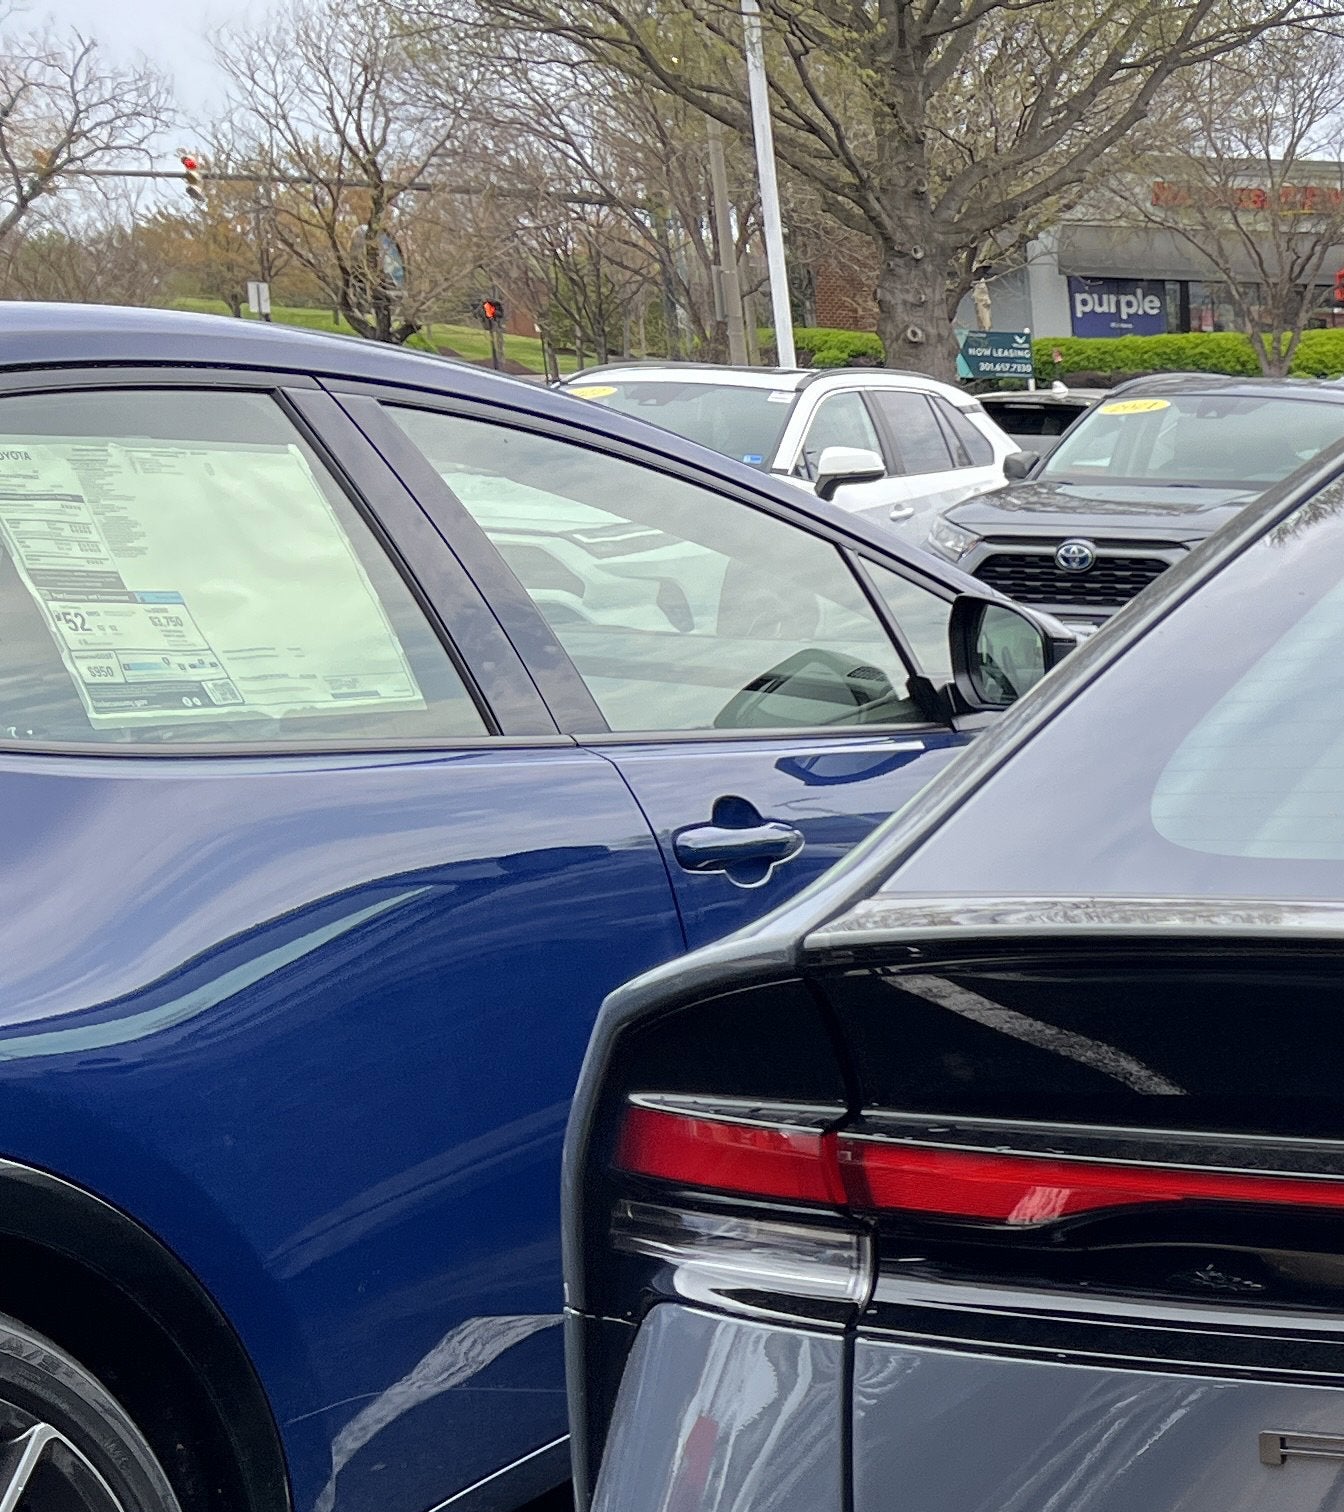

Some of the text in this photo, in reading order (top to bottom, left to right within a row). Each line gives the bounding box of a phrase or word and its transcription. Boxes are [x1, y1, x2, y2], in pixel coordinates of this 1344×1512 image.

[1073, 287, 1161, 320] purple
[968, 347, 1032, 358] NOW LEASING
[63, 611, 93, 632] 52
[87, 665, 114, 678] $950
